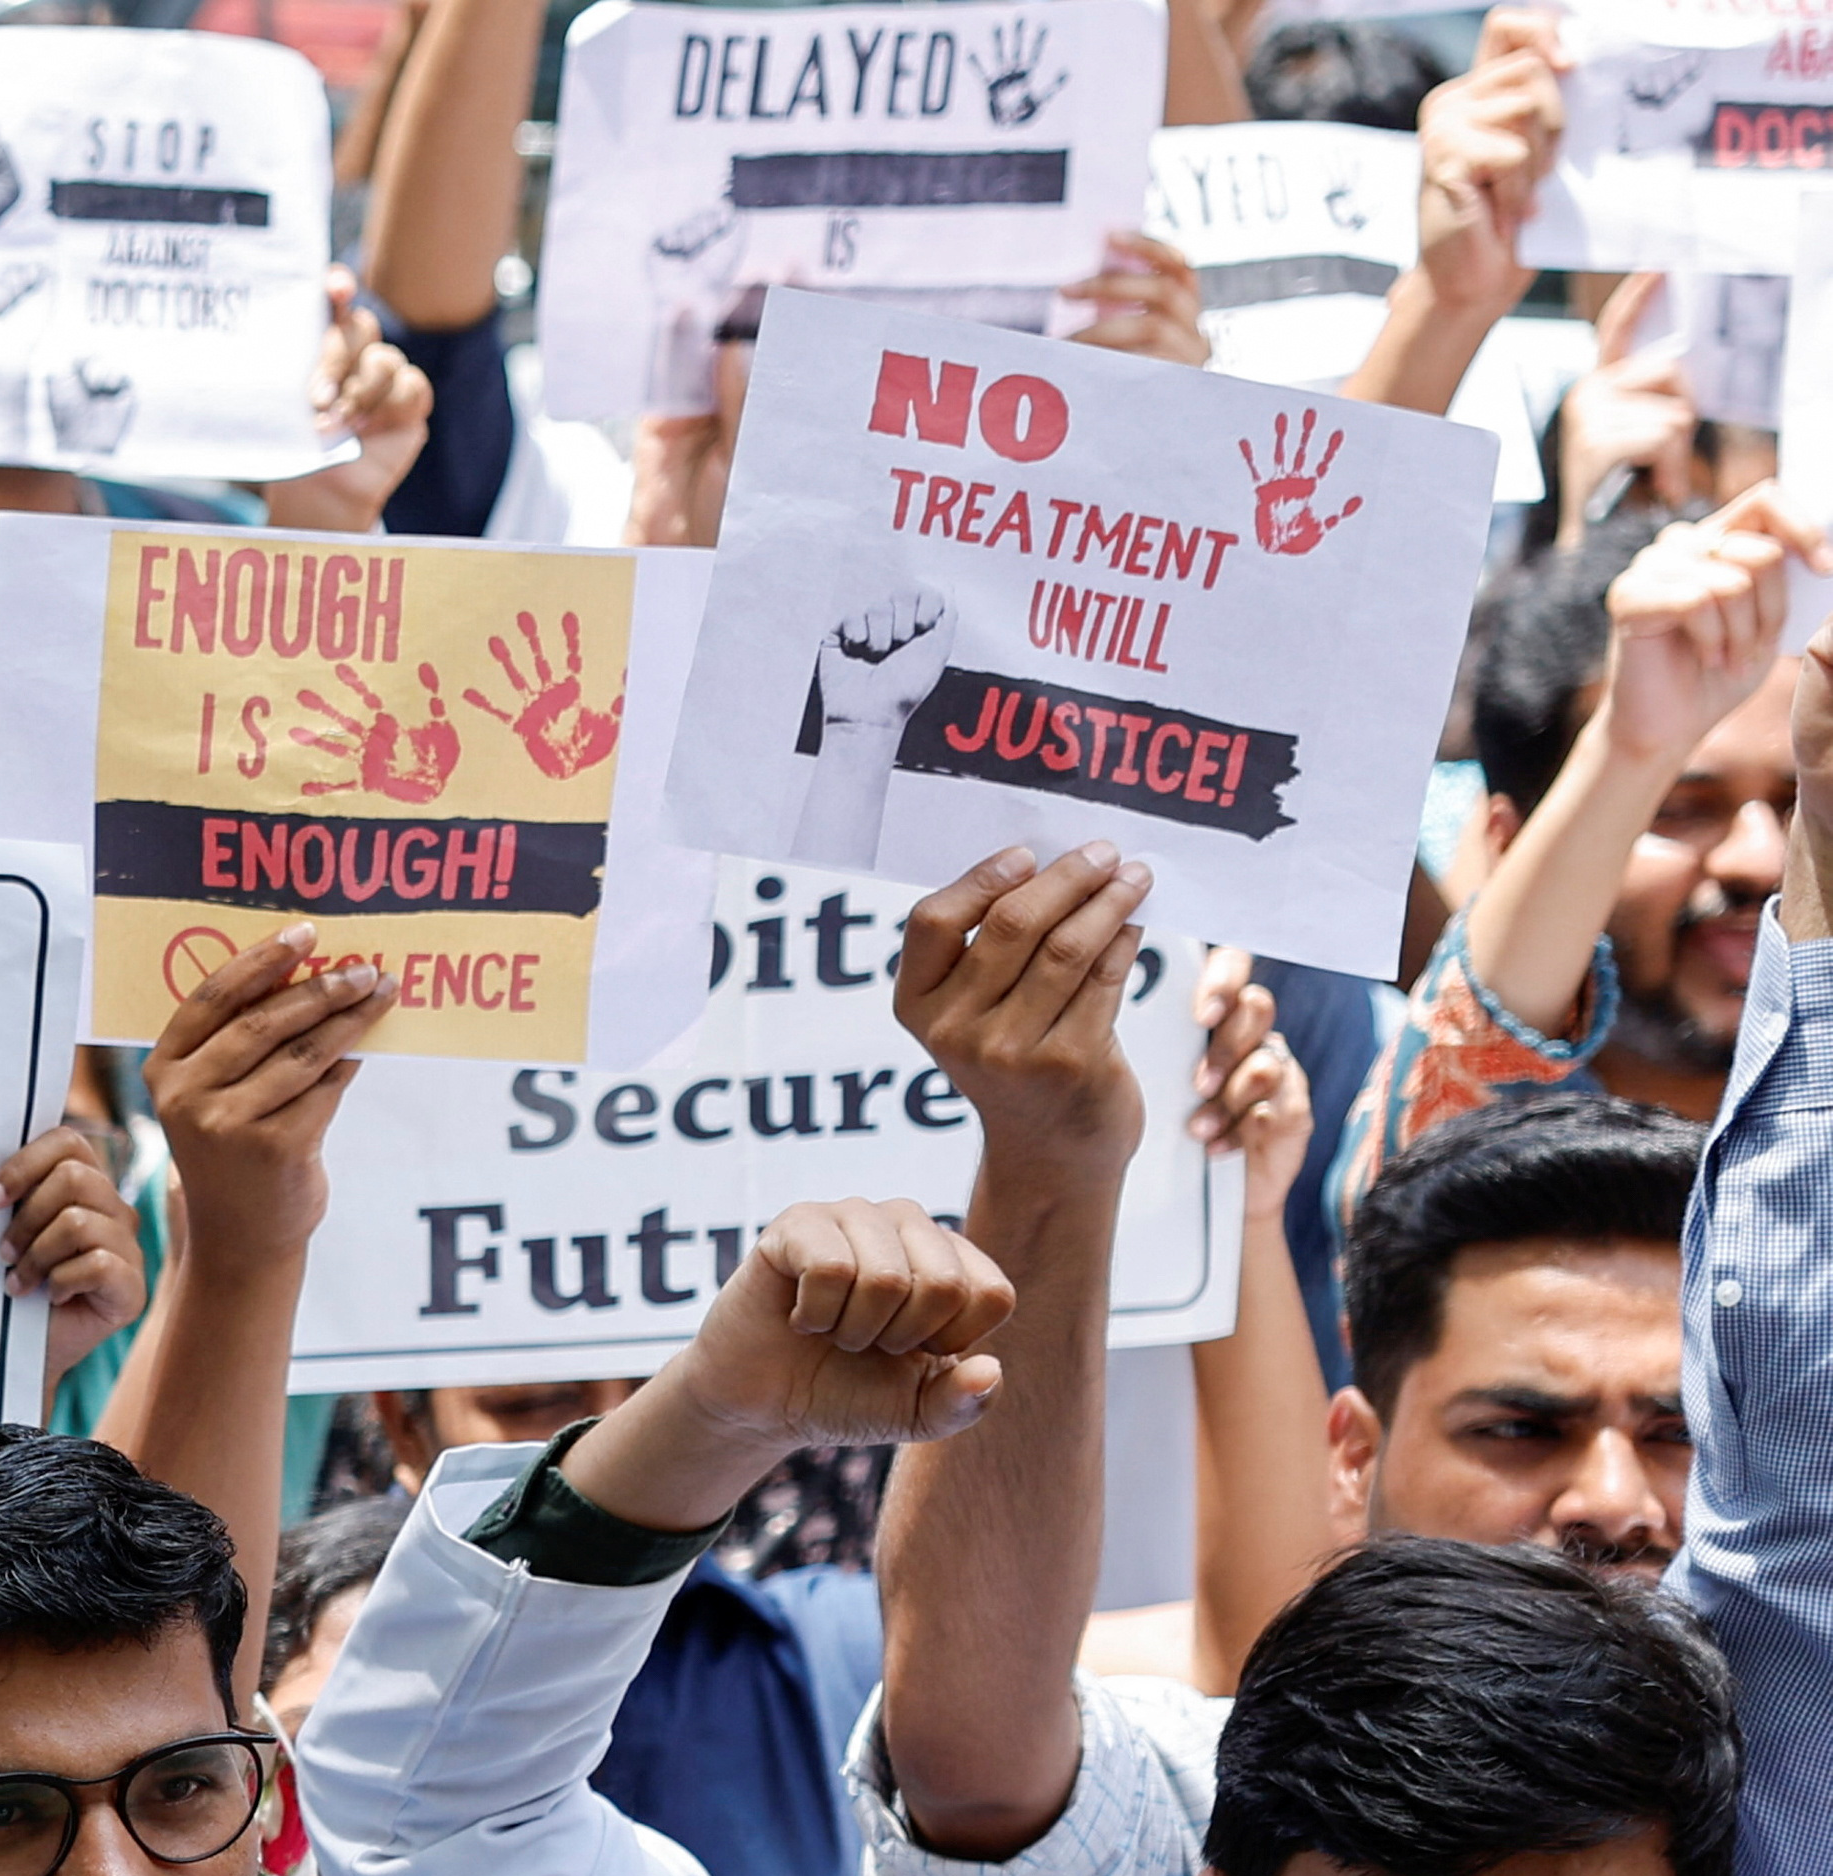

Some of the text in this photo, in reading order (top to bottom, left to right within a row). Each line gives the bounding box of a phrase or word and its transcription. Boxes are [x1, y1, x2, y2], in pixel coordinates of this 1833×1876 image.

[676, 27, 957, 119] DELAYED
[88, 118, 217, 173] STOP
[869, 349, 1069, 464] NO
[890, 467, 1238, 590] TREATMENT
[134, 546, 404, 663] ENOUGH
[1030, 579, 1172, 674] UNTILL
[944, 686, 1249, 808] JUSTICE!
[201, 818, 516, 902] ENOUGH!
[508, 1067, 969, 1155] Secure
